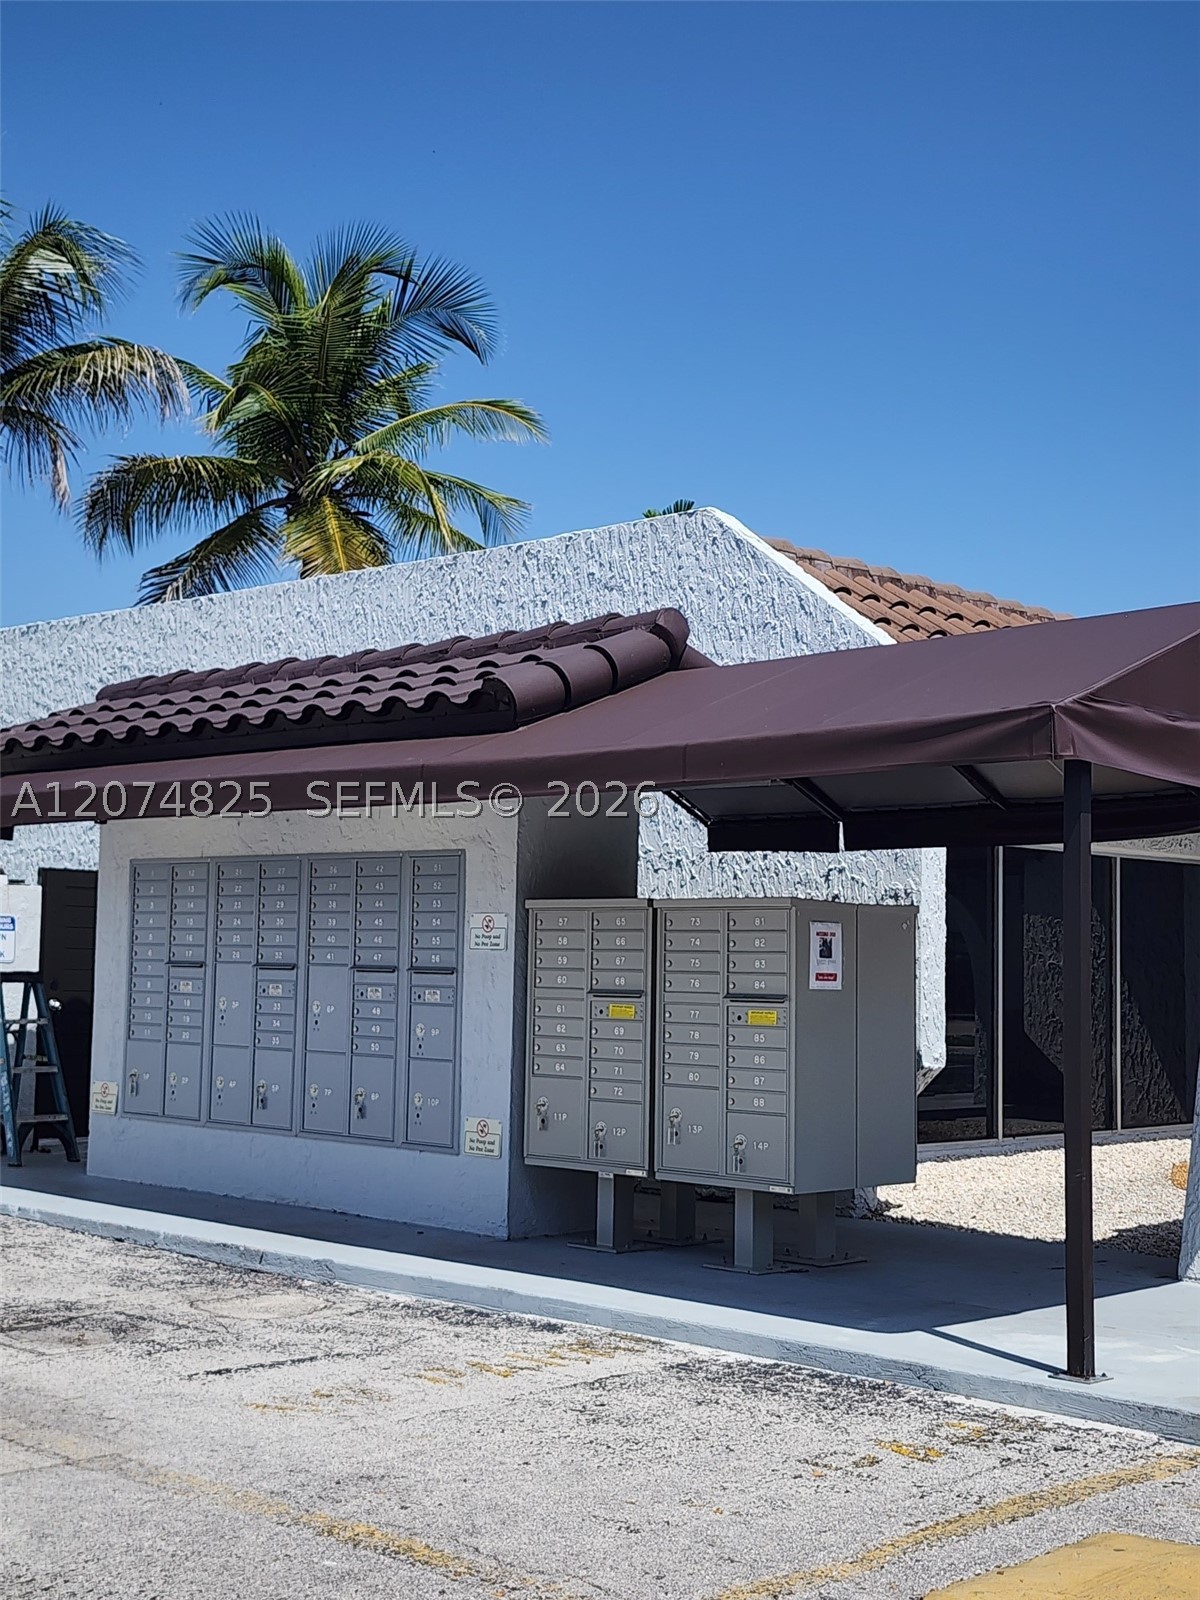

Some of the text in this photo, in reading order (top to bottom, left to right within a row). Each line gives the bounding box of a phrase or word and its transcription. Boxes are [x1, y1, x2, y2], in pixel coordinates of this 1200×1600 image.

[558, 917, 568, 927] 57
[615, 917, 626, 926] 65
[690, 917, 701, 926] 73
[754, 917, 765, 927] 81
[558, 936, 568, 945] 58
[615, 937, 626, 946] 66
[690, 938, 701, 947] 74
[754, 938, 766, 948] 82
[557, 956, 568, 965] 59
[615, 956, 626, 966] 67
[690, 958, 701, 968] 75
[754, 959, 766, 969] 83
[557, 975, 567, 984] 60
[615, 976, 625, 986] 68
[689, 979, 700, 988] 76
[754, 980, 766, 990] 84
[556, 1004, 565, 1014] 61
[689, 1010, 700, 1019] 77
[556, 1024, 566, 1033] 62
[614, 1026, 625, 1036] 69
[689, 1030, 700, 1040] 78
[753, 1033, 765, 1043] 85
[555, 1043, 566, 1052] 63
[613, 1046, 624, 1056] 70
[689, 1051, 700, 1061] 79
[753, 1055, 766, 1065] 86
[555, 1063, 565, 1072] 64
[614, 1066, 623, 1076] 71
[688, 1072, 700, 1082] 80
[753, 1076, 765, 1086] 87
[613, 1086, 623, 1096] 72
[753, 1097, 765, 1107] 88
[553, 1112, 568, 1121] 11P
[612, 1127, 627, 1137] 12P
[688, 1124, 703, 1134] 13P
[753, 1141, 769, 1151] 14P
